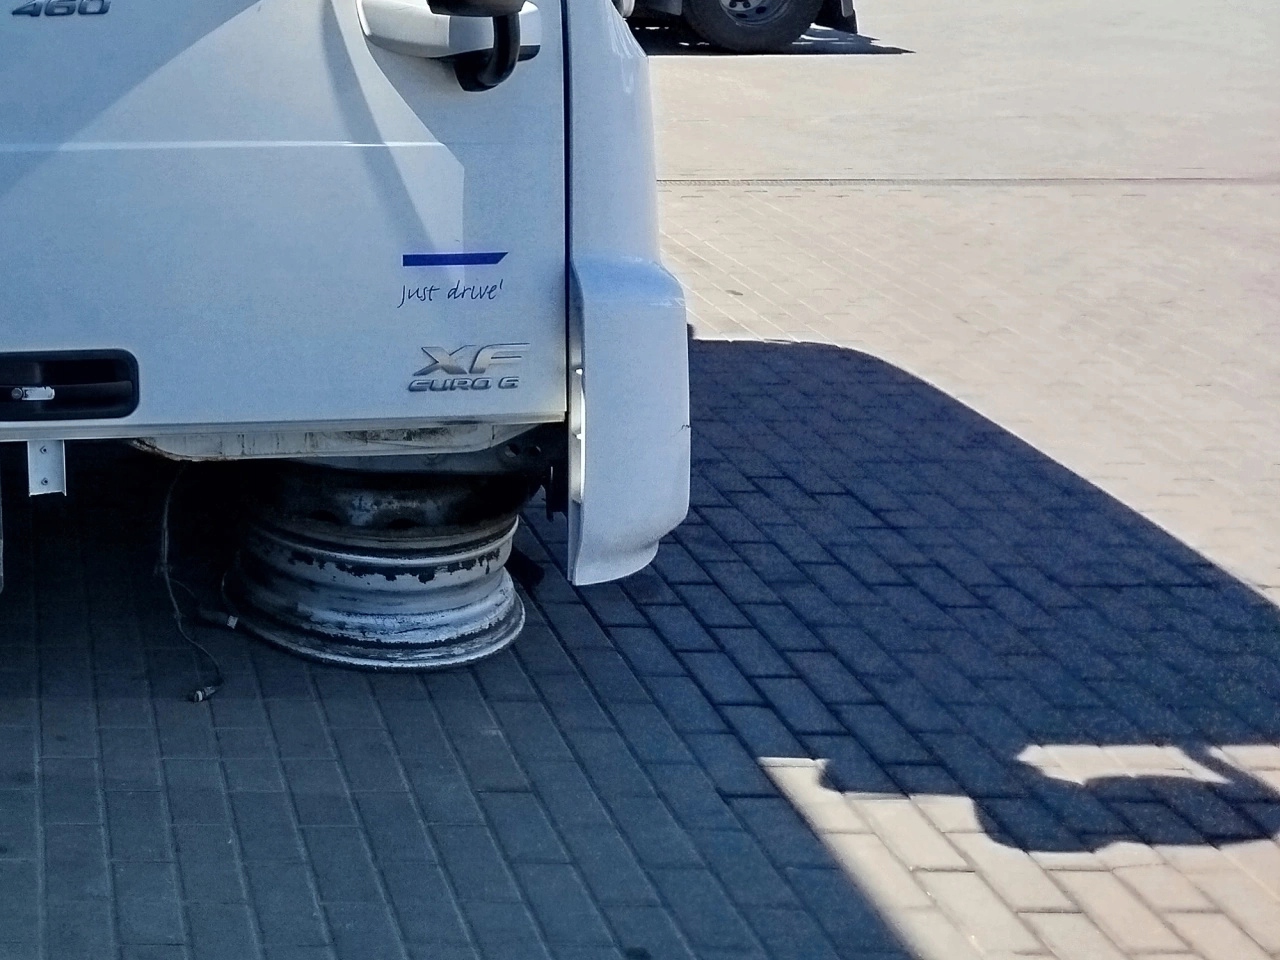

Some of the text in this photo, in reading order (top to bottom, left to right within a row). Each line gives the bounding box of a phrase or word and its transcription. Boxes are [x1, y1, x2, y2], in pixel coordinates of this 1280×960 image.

[413, 342, 530, 376] XF
[408, 376, 520, 392] EURO 6
